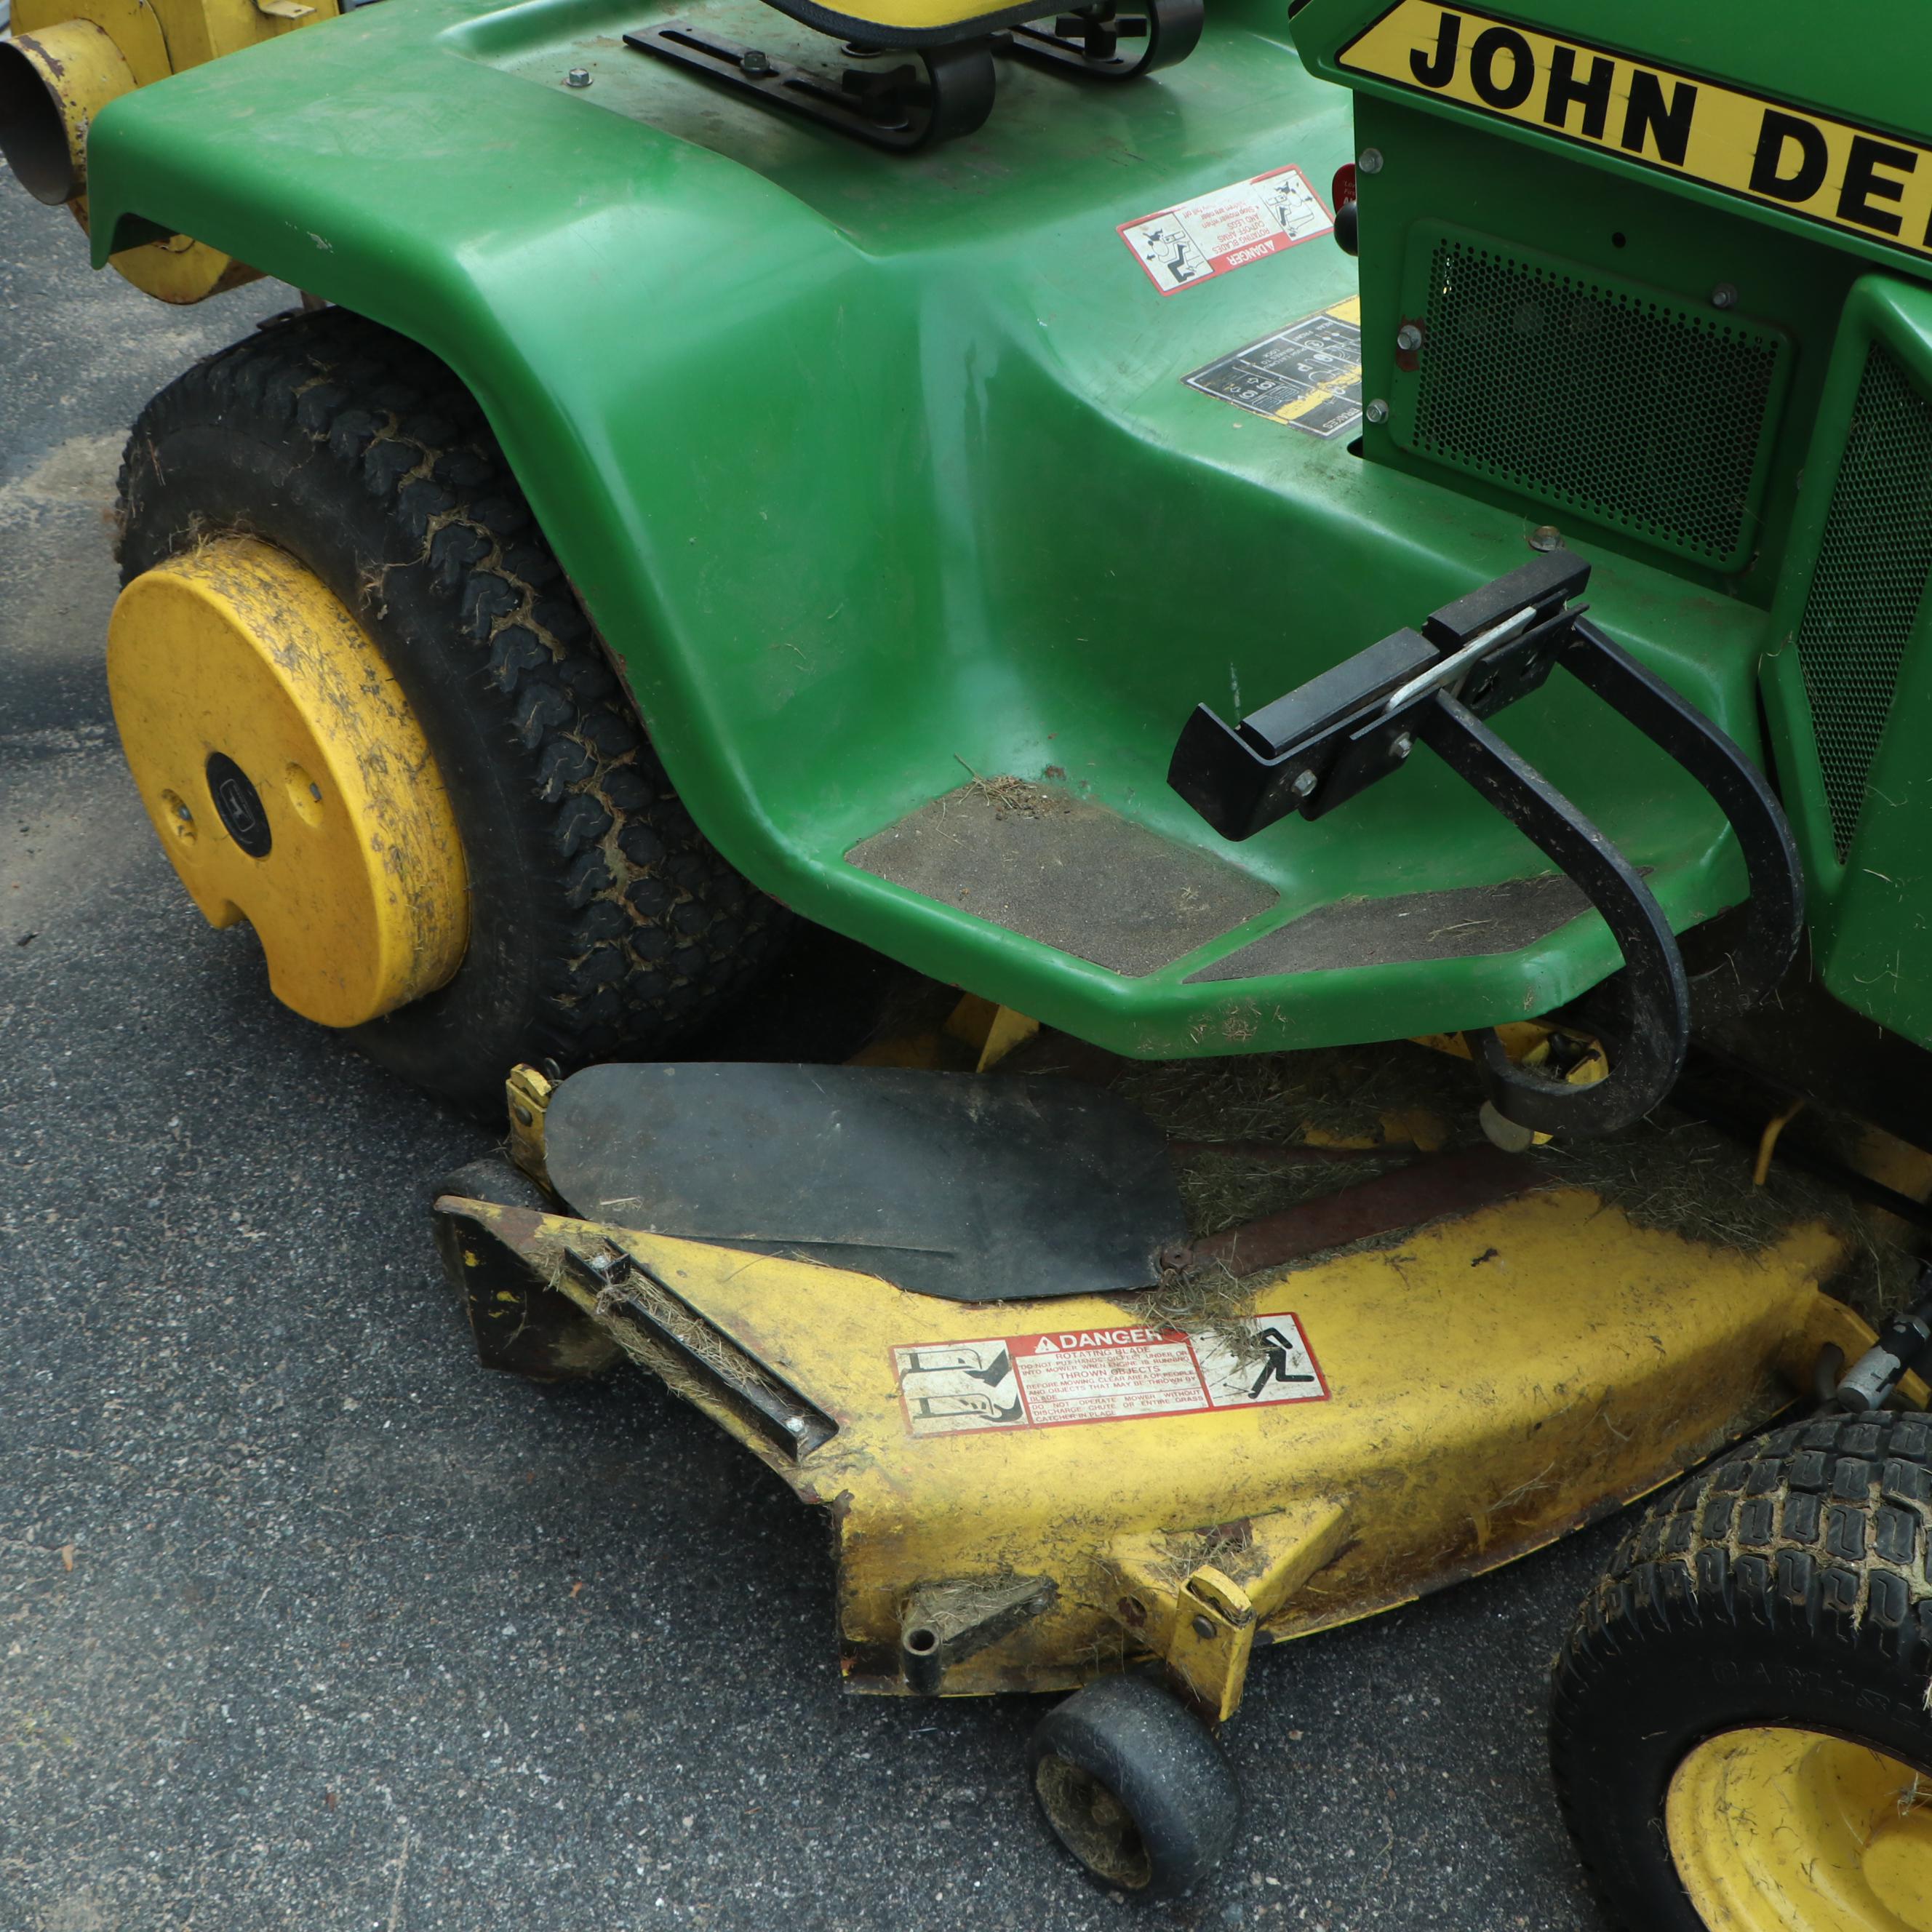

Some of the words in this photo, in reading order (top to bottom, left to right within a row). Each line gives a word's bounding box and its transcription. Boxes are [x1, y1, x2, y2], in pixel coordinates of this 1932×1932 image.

[1410, 12, 1698, 167] JOHN
[1749, 108, 1932, 249] DE
[1227, 218, 1245, 230] LEGS
[1245, 213, 1259, 223] AND
[1217, 231, 1237, 242] ARMS
[1239, 228, 1270, 244] ROTATING
[1211, 239, 1240, 255] BLADES
[1226, 242, 1267, 266] DANGER
[1322, 407, 1360, 429] BRAKES
[1059, 1329, 1162, 1349] DANGER
[1055, 1349, 1112, 1360] ROTATING
[1115, 1346, 1151, 1355] BLADE
[1147, 1351, 1173, 1359] UNDER
[1046, 1365, 1077, 1373] MOWER
[1082, 1362, 1106, 1370] WHEN
[1108, 1360, 1136, 1368] ENGINE
[1153, 1356, 1190, 1364] RUNNING
[1058, 1370, 1107, 1380] THROWN
[1111, 1365, 1161, 1376] OBJECTS
[1026, 1381, 1059, 1390] BEFORE
[1061, 1378, 1095, 1386] MOWING
[1098, 1376, 1125, 1384] CLEAR
[1127, 1373, 1149, 1381] AREA
[1163, 1370, 1194, 1378] PEOPLE
[1048, 1385, 1086, 1394] OBJECTS
[1149, 1377, 1183, 1386] THROWN
[1029, 1394, 1058, 1402] BLADE
[1079, 1397, 1118, 1405] OPERATE
[1125, 1394, 1156, 1402] MOWER
[1163, 1389, 1201, 1398] WITHOUT
[1033, 1408, 1082, 1417] DISCHARGE
[1088, 1403, 1117, 1411] CHUTE
[1141, 1398, 1170, 1407] ENTIRE
[1175, 1395, 1204, 1403] GRASS
[1035, 1413, 1076, 1423] CATCHER
[1089, 1409, 1117, 1418] PLACE
